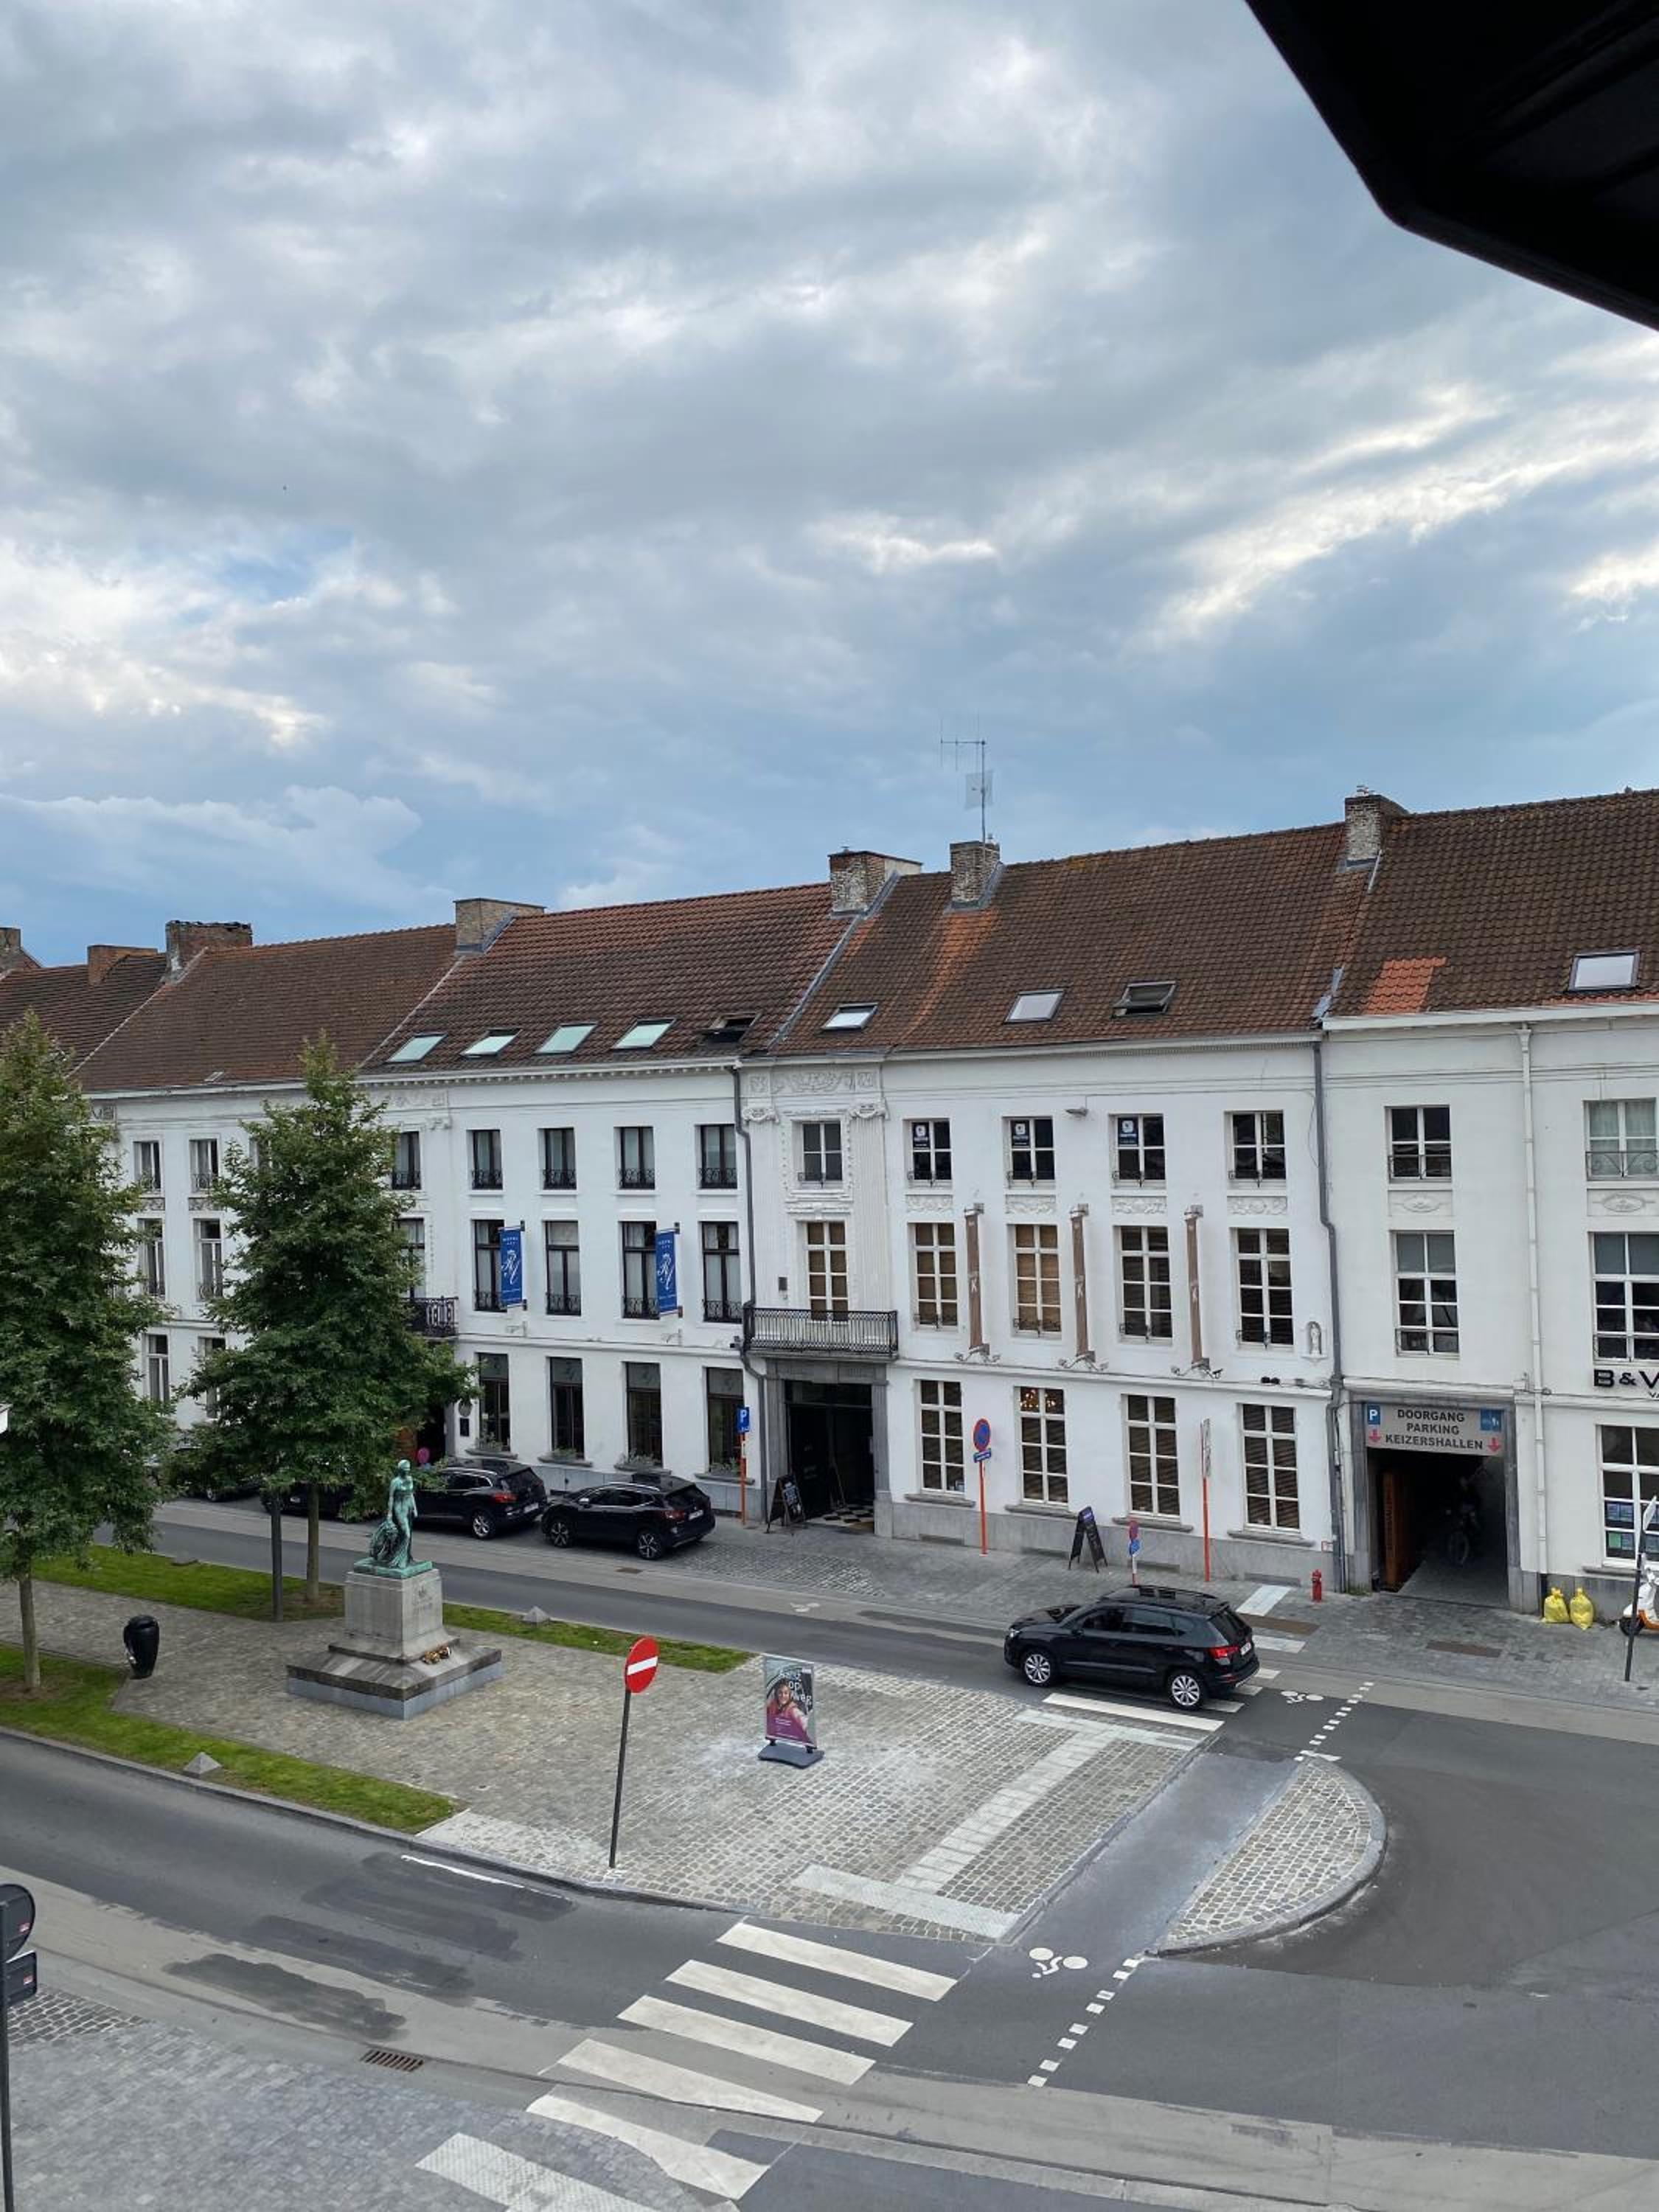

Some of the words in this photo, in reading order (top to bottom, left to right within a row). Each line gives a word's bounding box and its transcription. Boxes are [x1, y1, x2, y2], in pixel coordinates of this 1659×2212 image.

[740, 1409, 747, 1423] P
[1369, 1409, 1378, 1421] P
[1397, 1408, 1465, 1422] DOORGANG
[1406, 1422, 1460, 1436] PARKING
[1385, 1433, 1483, 1450] KEIZERSHALLEN
